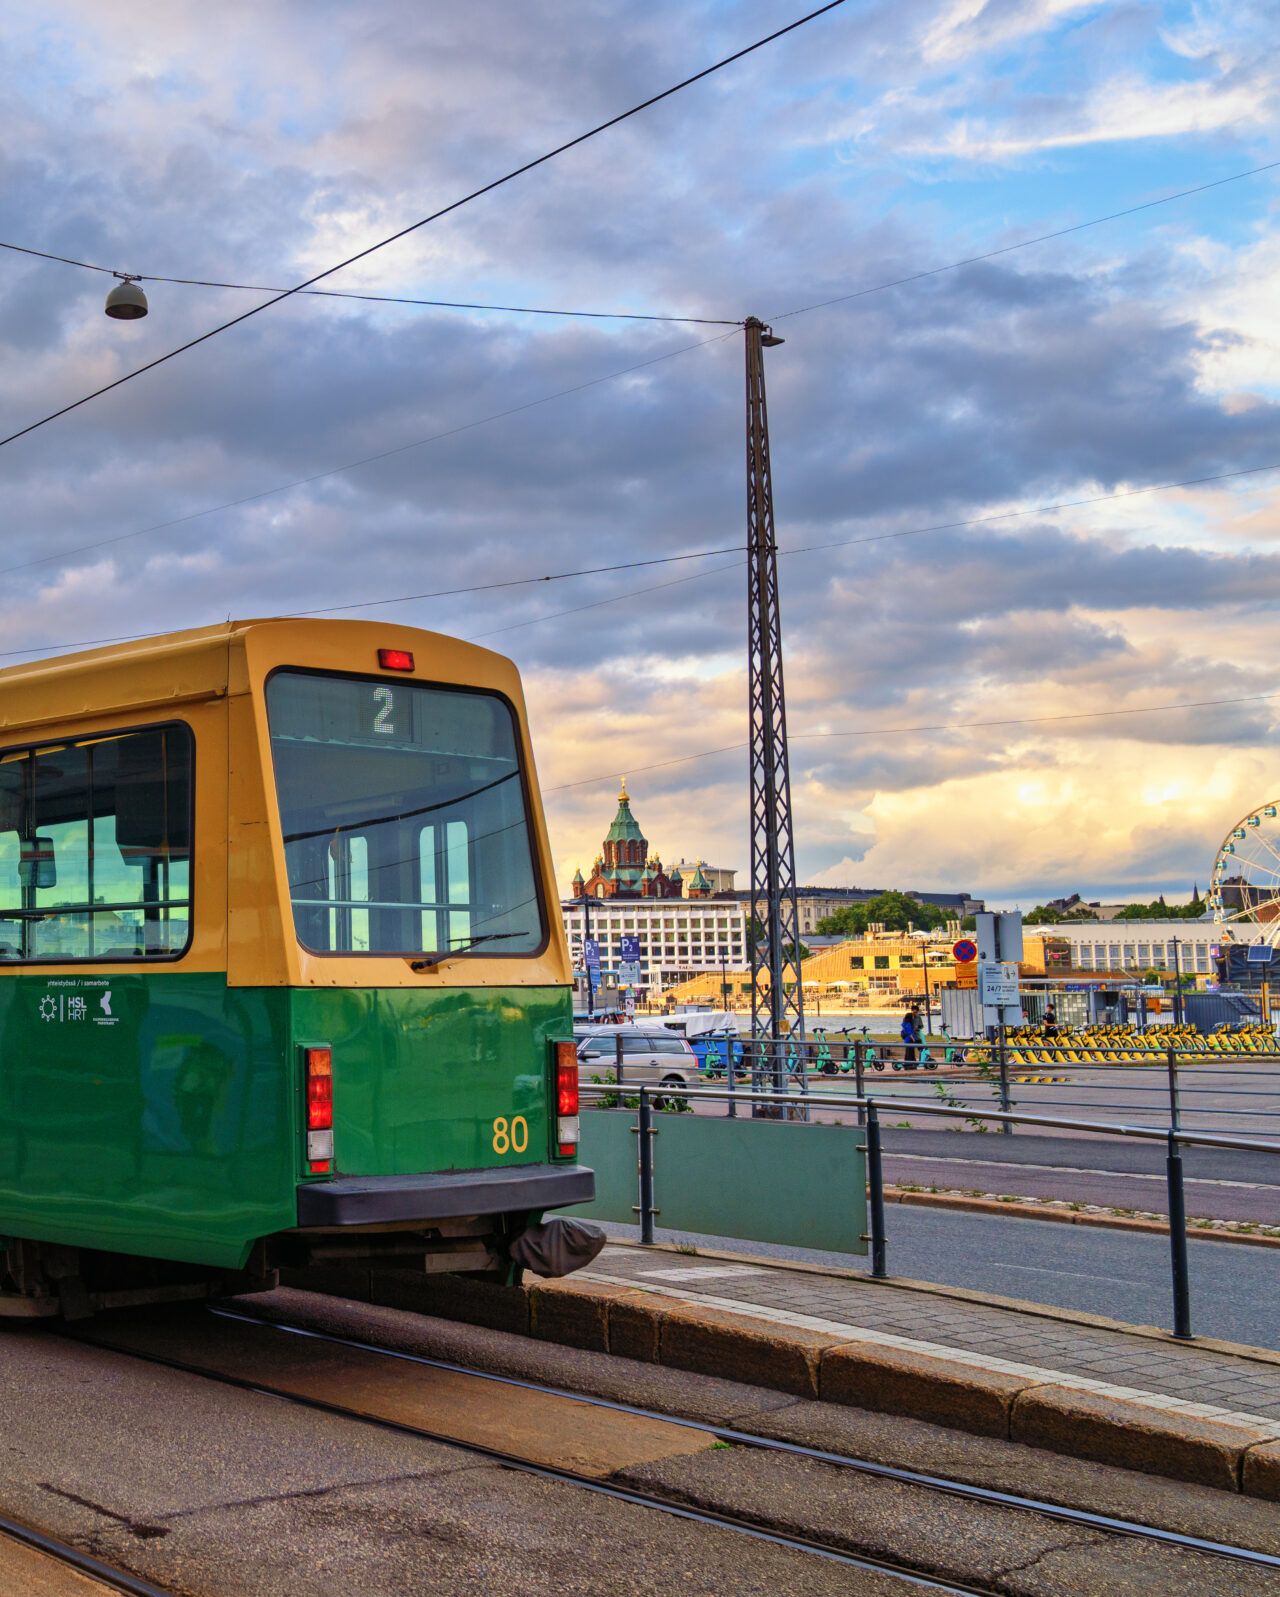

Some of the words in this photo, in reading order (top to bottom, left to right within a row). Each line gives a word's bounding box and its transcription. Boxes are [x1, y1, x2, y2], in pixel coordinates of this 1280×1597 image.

[373, 687, 394, 733] 2
[67, 996, 87, 1008] HSL
[67, 1008, 87, 1021] HRT
[492, 1115, 528, 1154] 80
